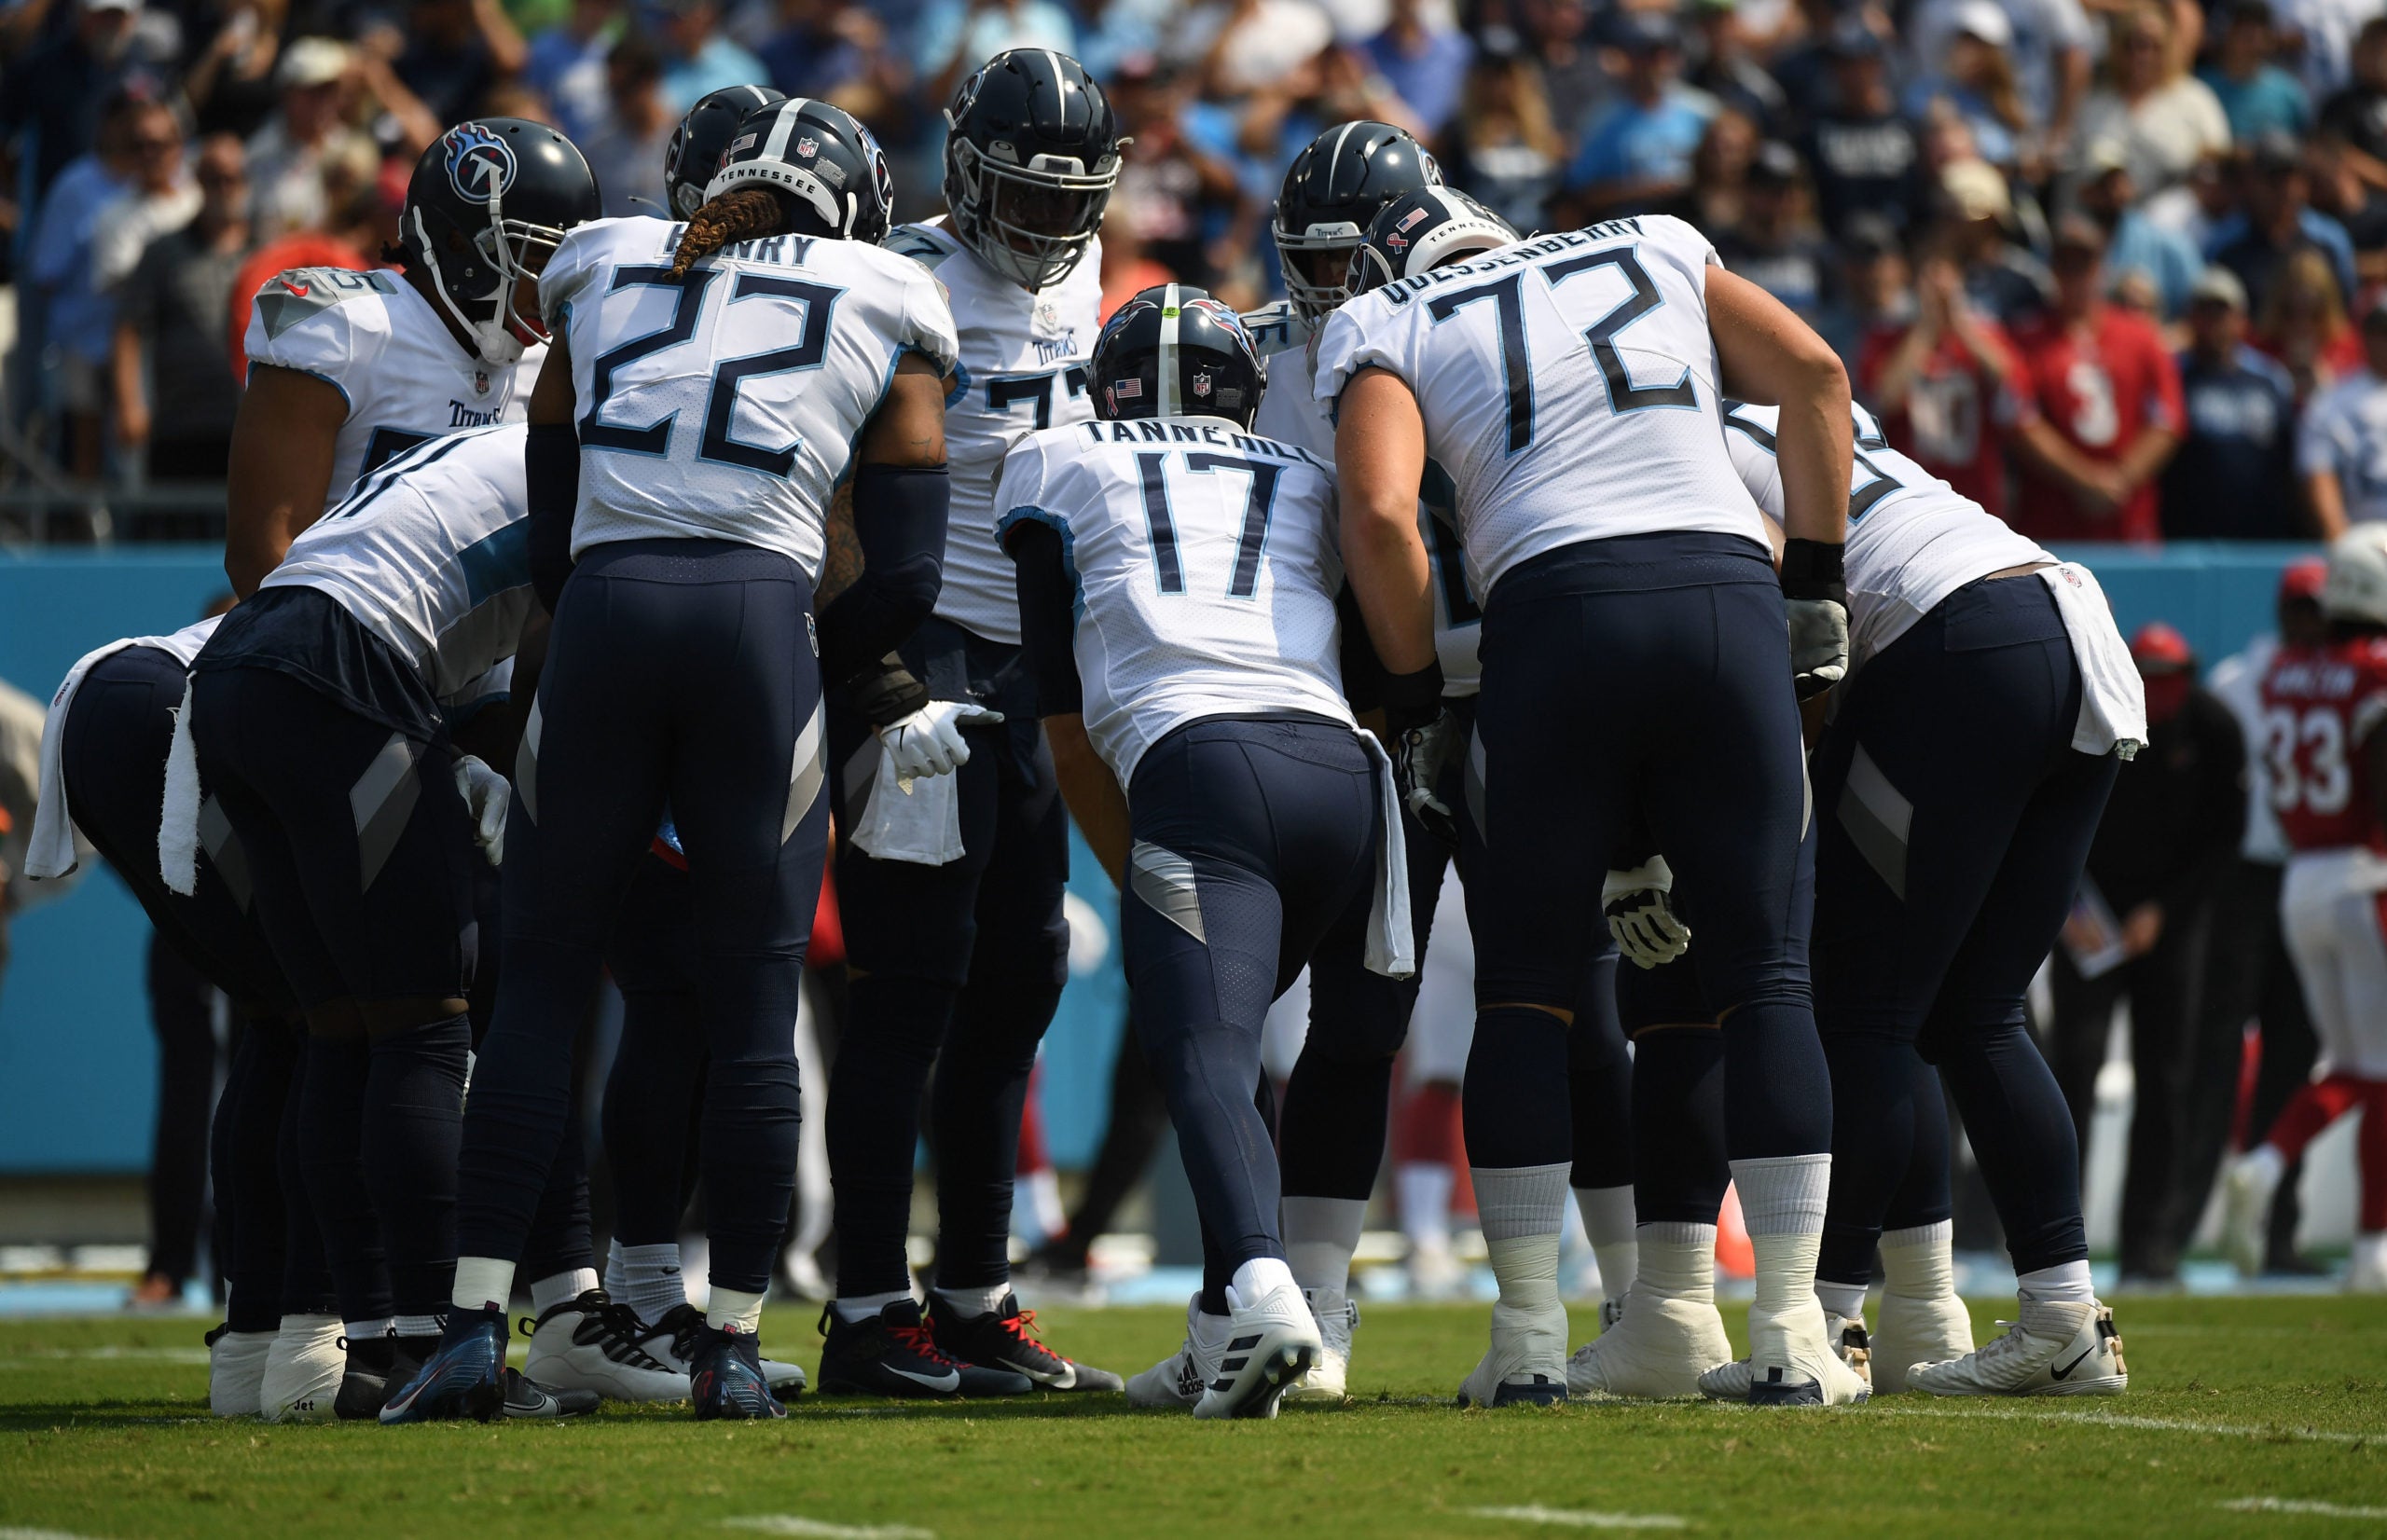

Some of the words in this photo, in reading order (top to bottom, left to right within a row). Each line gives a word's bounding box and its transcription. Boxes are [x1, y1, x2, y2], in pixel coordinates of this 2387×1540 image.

[720, 168, 816, 195] TENNESSEE
[579, 264, 850, 482] 22
[1421, 243, 1703, 460] 72
[1132, 450, 1290, 601] 17
[2266, 705, 2352, 814] 33
[294, 1398, 314, 1410] Jet
